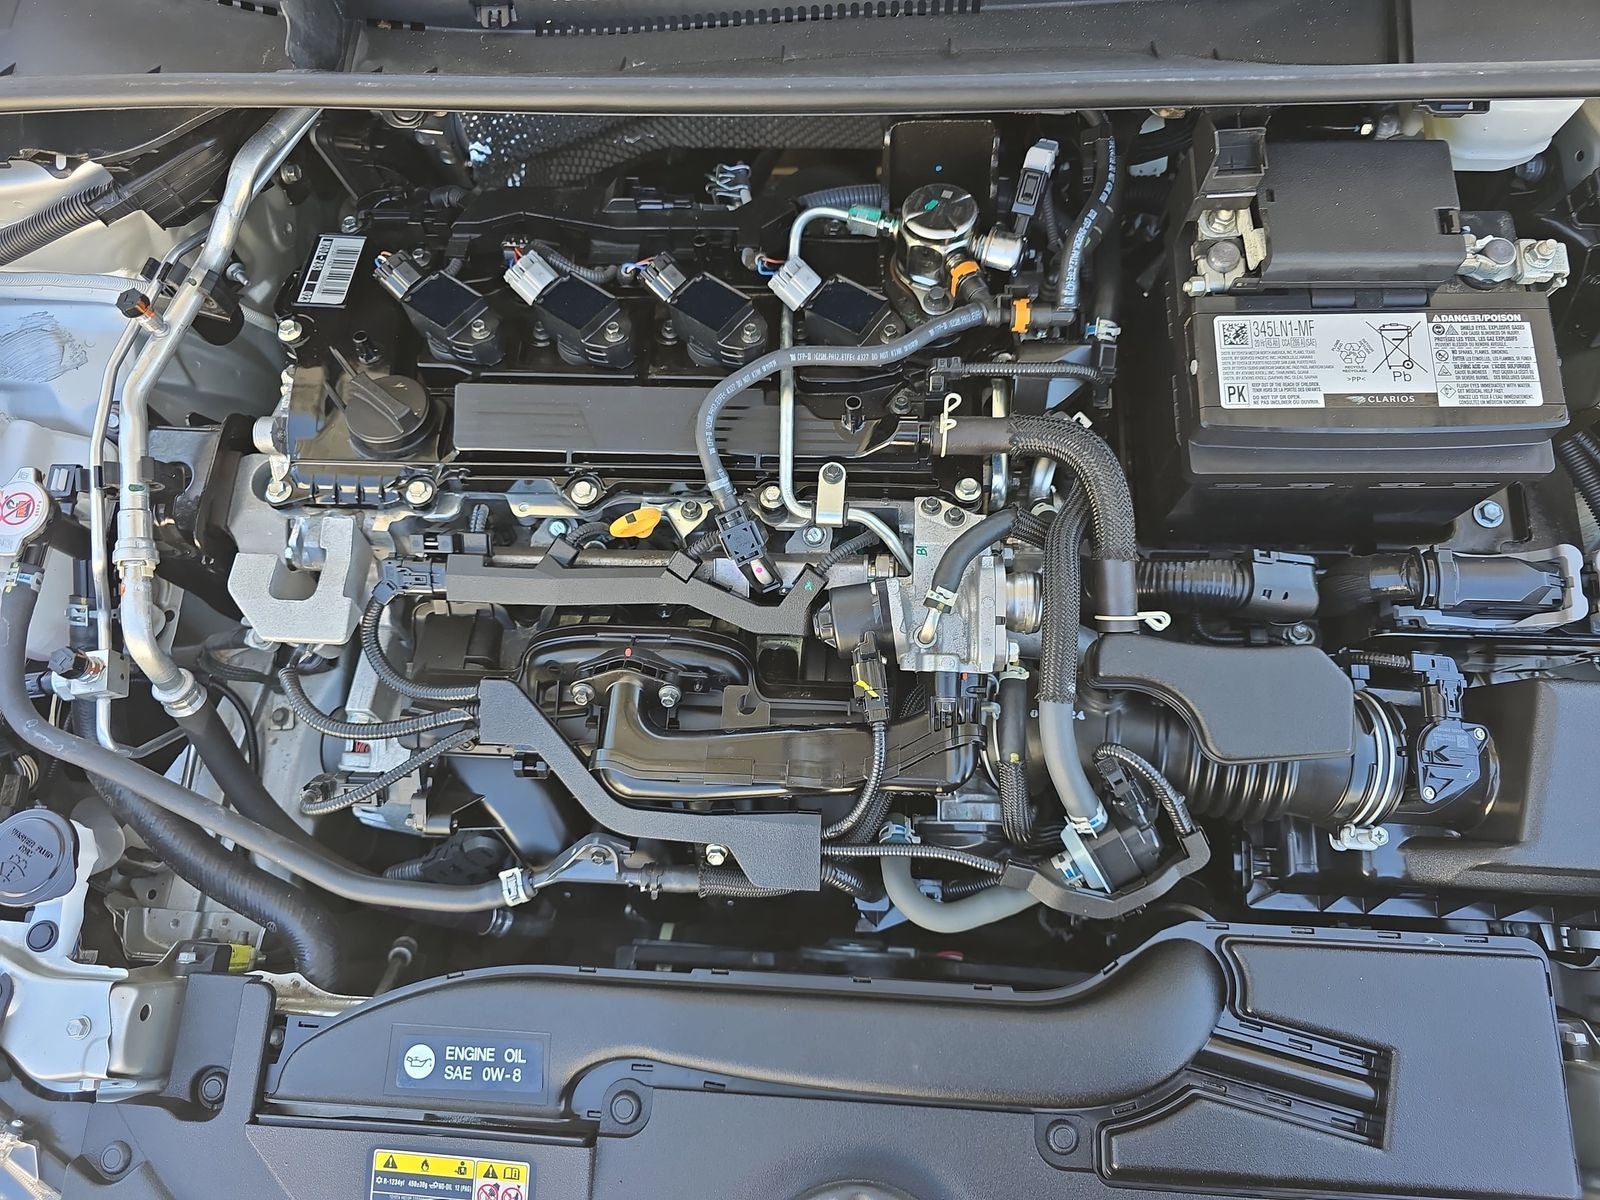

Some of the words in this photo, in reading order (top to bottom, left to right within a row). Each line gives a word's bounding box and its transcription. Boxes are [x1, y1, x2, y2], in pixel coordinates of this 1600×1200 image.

[1253, 320, 1314, 337] 345LN1-MF
[1393, 371, 1412, 382] Pb
[1228, 386, 1246, 402] PK
[446, 1046, 495, 1062] ENGINE
[504, 1048, 527, 1064] OIL
[444, 1066, 472, 1080] SAE
[482, 1067, 521, 1082] 0W-8
